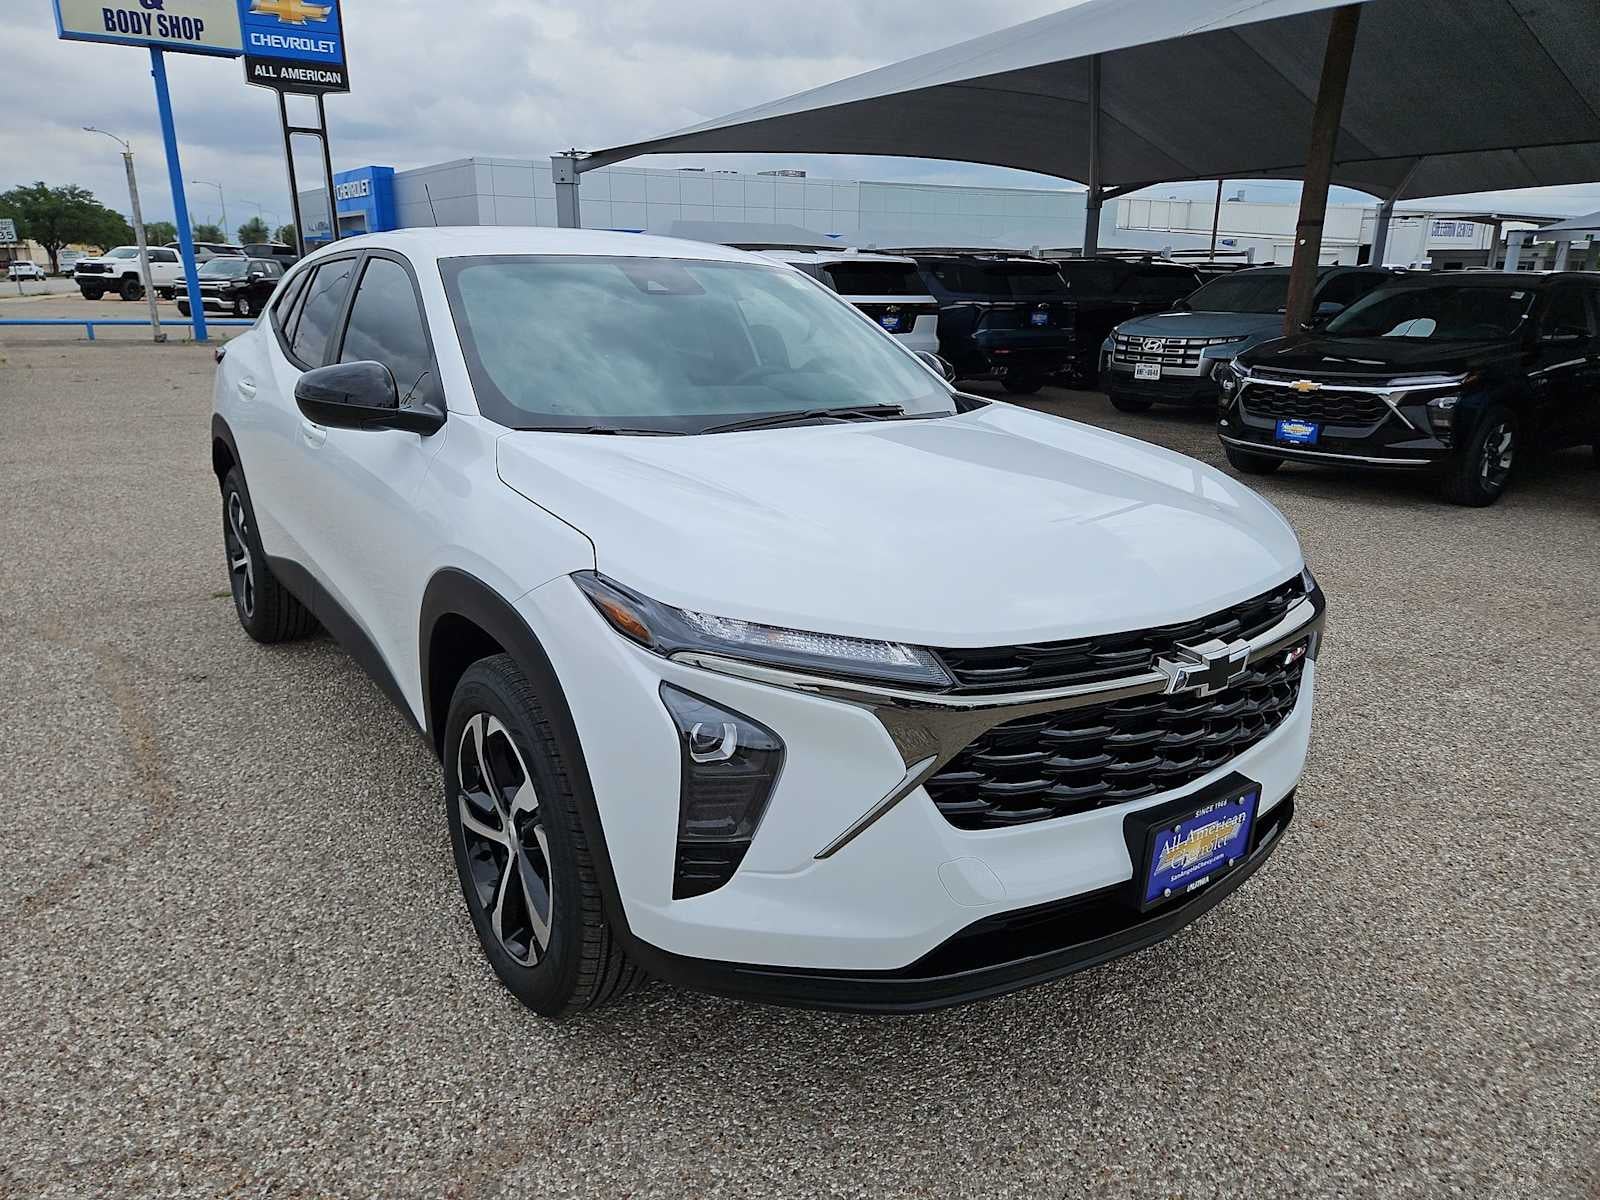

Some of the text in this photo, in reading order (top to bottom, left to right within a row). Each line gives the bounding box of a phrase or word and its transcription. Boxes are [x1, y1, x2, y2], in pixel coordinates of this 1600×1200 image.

[102, 8, 204, 40] BODY SHOP
[250, 32, 336, 54] CHEVROLET
[254, 64, 342, 84] ALL AMERICAN
[1195, 804, 1214, 818] SINCE
[1159, 812, 1247, 860] All American
